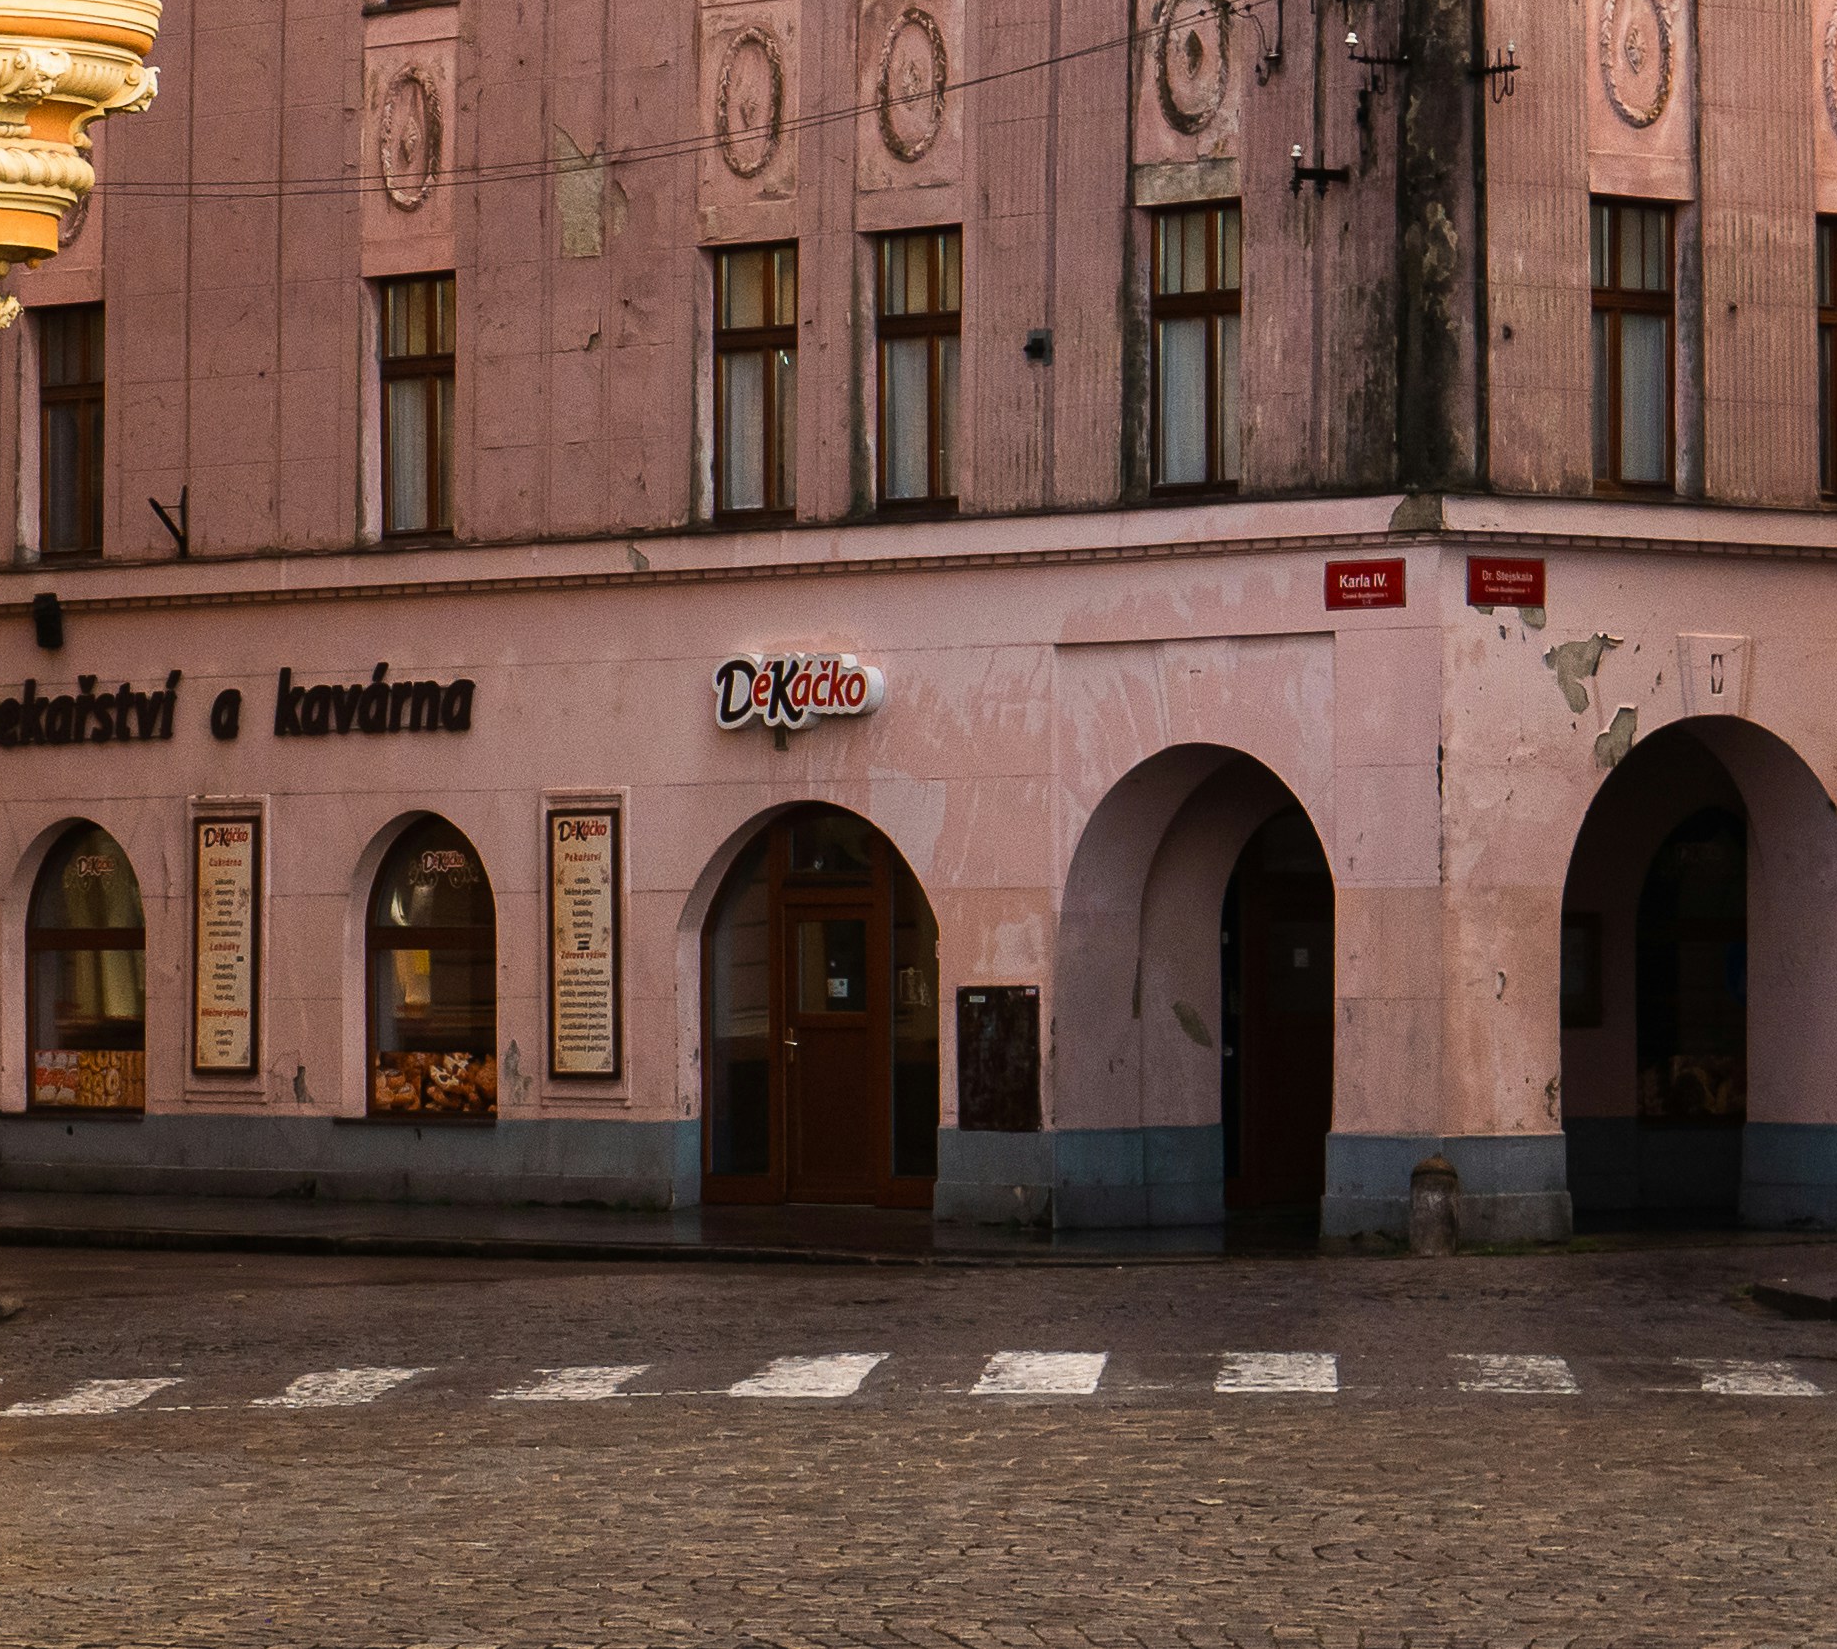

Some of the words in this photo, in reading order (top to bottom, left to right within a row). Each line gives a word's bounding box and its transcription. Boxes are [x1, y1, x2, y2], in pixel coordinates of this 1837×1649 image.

[1339, 573, 1370, 588] Karla
[1374, 573, 1388, 587] IV.
[1482, 570, 1494, 581] Dr.
[1496, 570, 1533, 583] Stejskala
[210, 688, 242, 741] a
[274, 662, 476, 736] kavárna
